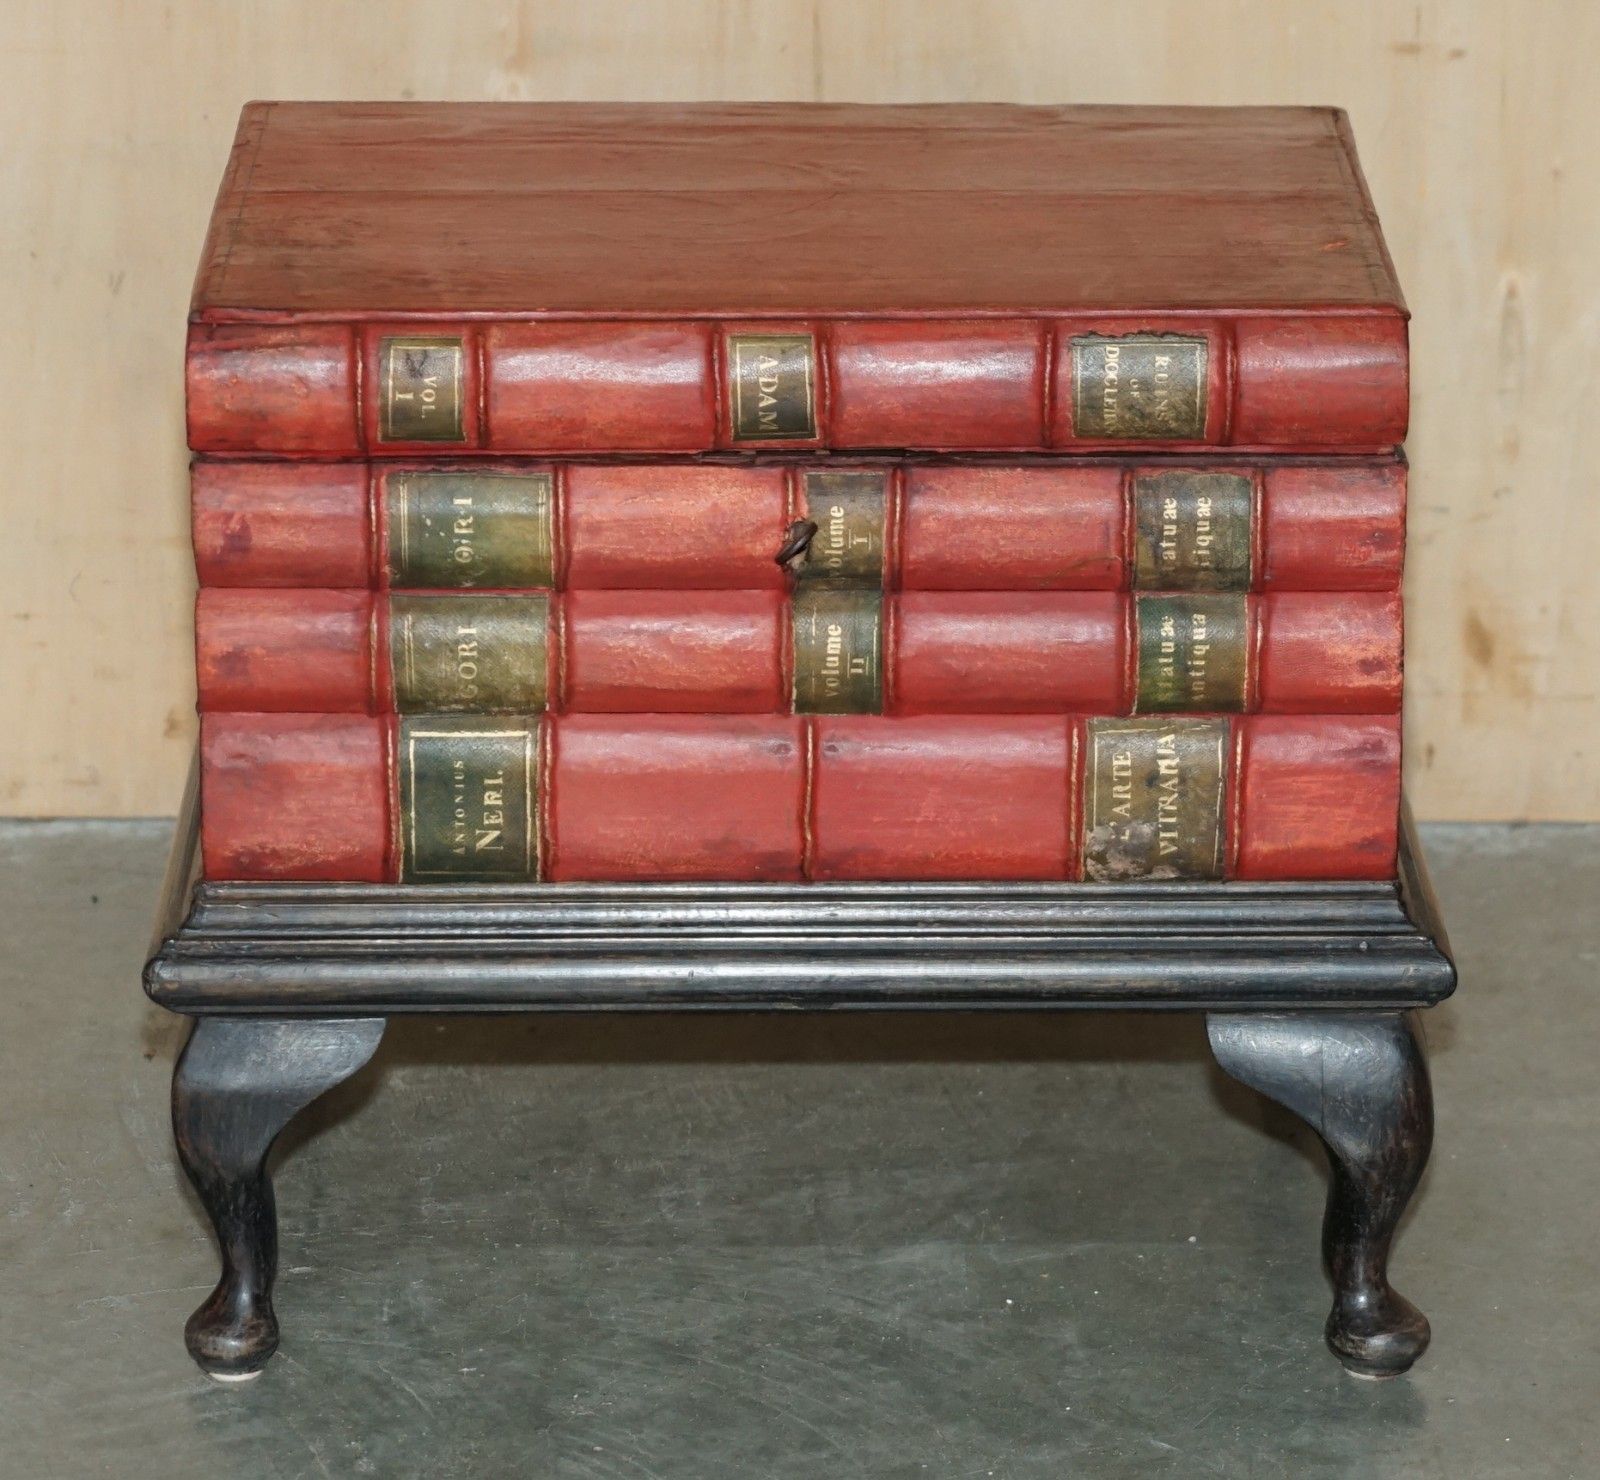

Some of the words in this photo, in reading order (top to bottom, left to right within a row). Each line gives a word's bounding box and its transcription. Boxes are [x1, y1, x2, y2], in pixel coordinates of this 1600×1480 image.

[420, 376, 438, 419] VOL.
[759, 355, 779, 430] ADAM
[824, 505, 844, 575] olume
[821, 624, 842, 697] volume
[453, 760, 466, 855] ANTONIUS
